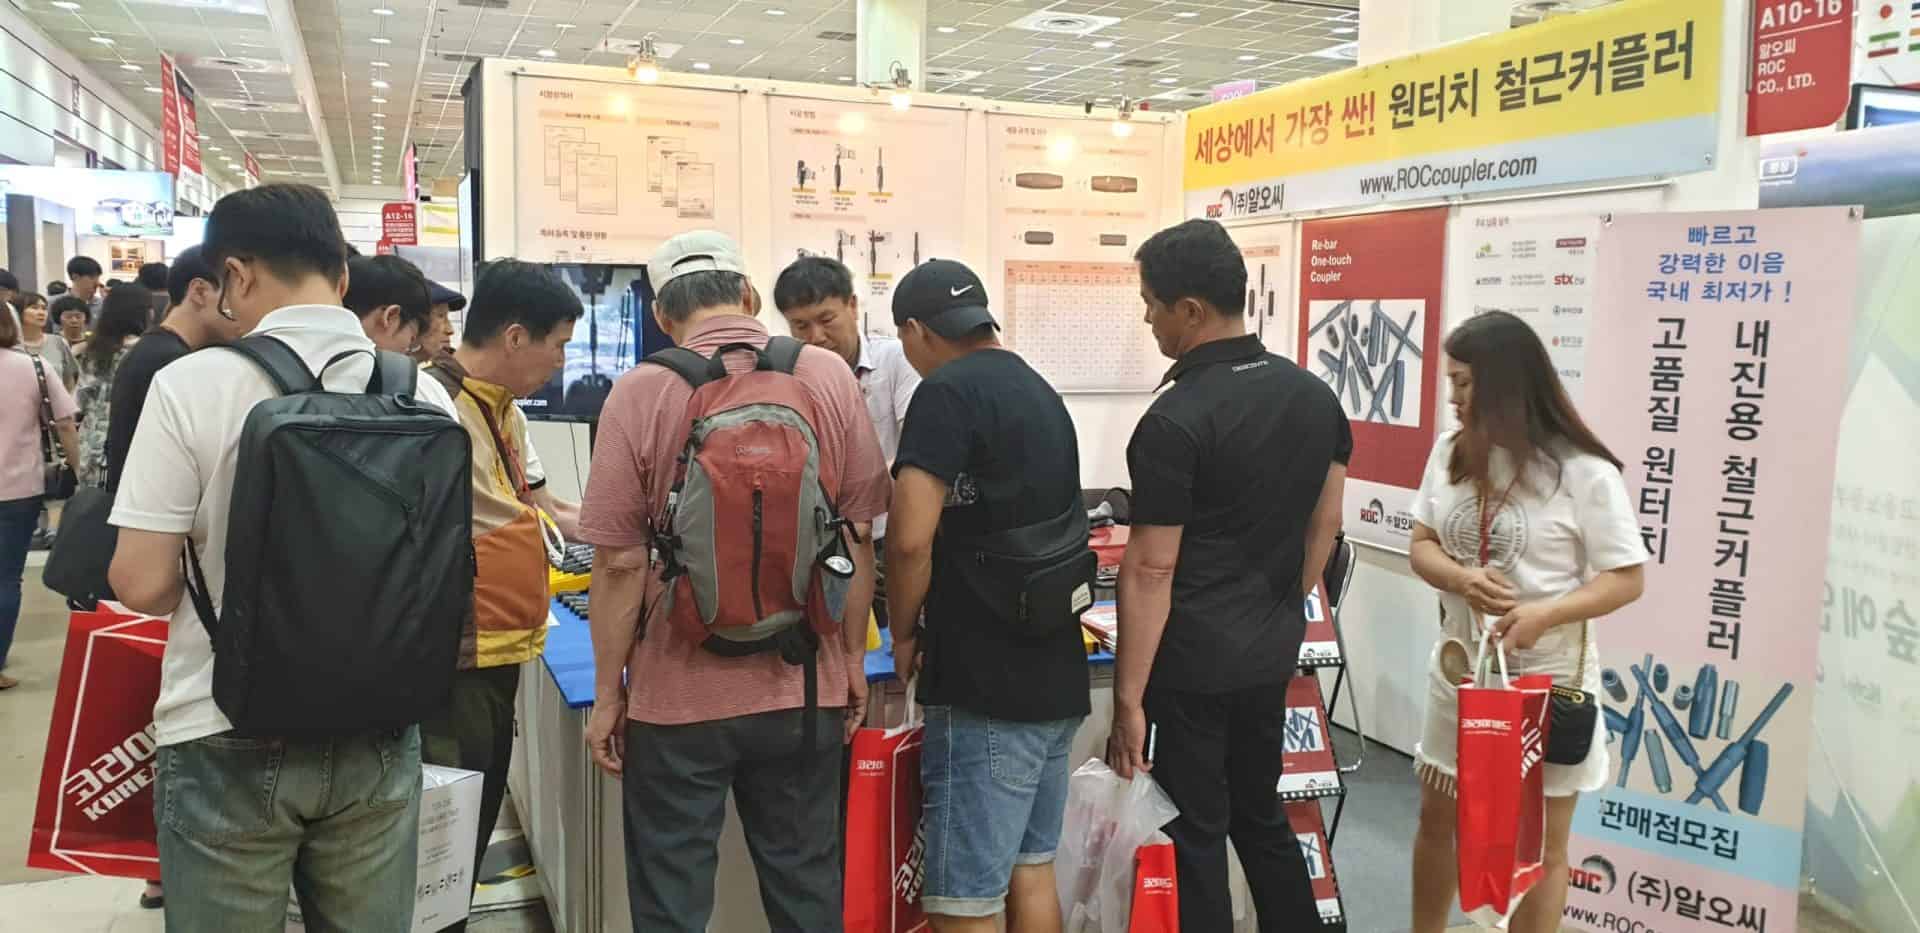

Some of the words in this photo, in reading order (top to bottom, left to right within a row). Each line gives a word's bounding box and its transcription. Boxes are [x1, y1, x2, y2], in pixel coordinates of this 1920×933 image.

[1760, 0, 1842, 29] A10-16
[1759, 38, 1796, 59] 알오씨
[1758, 59, 1786, 76] ROC
[1194, 113, 1275, 165] 세상에서
[1285, 101, 1333, 147] 가장
[1341, 91, 1376, 139] 싼!
[1388, 67, 1479, 131] 원터치
[1493, 20, 1694, 112] 철근커플러
[1787, 73, 1816, 90] LTD.
[1360, 156, 1537, 195] www.ROCcoupler.com
[1206, 203, 1223, 218] ROC
[1233, 183, 1285, 215] (주)알오씨
[1312, 239, 1338, 250] Re-bar
[1688, 225, 1757, 246] 빠르고
[1311, 253, 1352, 267] One-touch
[1659, 253, 1726, 275] 강력한
[1738, 252, 1785, 275] 이음
[1310, 271, 1342, 284] Coupler
[1647, 281, 1690, 302] 국내
[1701, 281, 1772, 303] 최저가
[1648, 317, 1687, 433] 고품질
[1725, 320, 1770, 441] 내진용
[1360, 508, 1379, 525] ROC
[1639, 446, 1675, 564] 원터치
[1707, 455, 1758, 660] 철근커플러
[1600, 799, 1740, 860] 판매점모집
[1628, 872, 1767, 933] (주)알오씨
